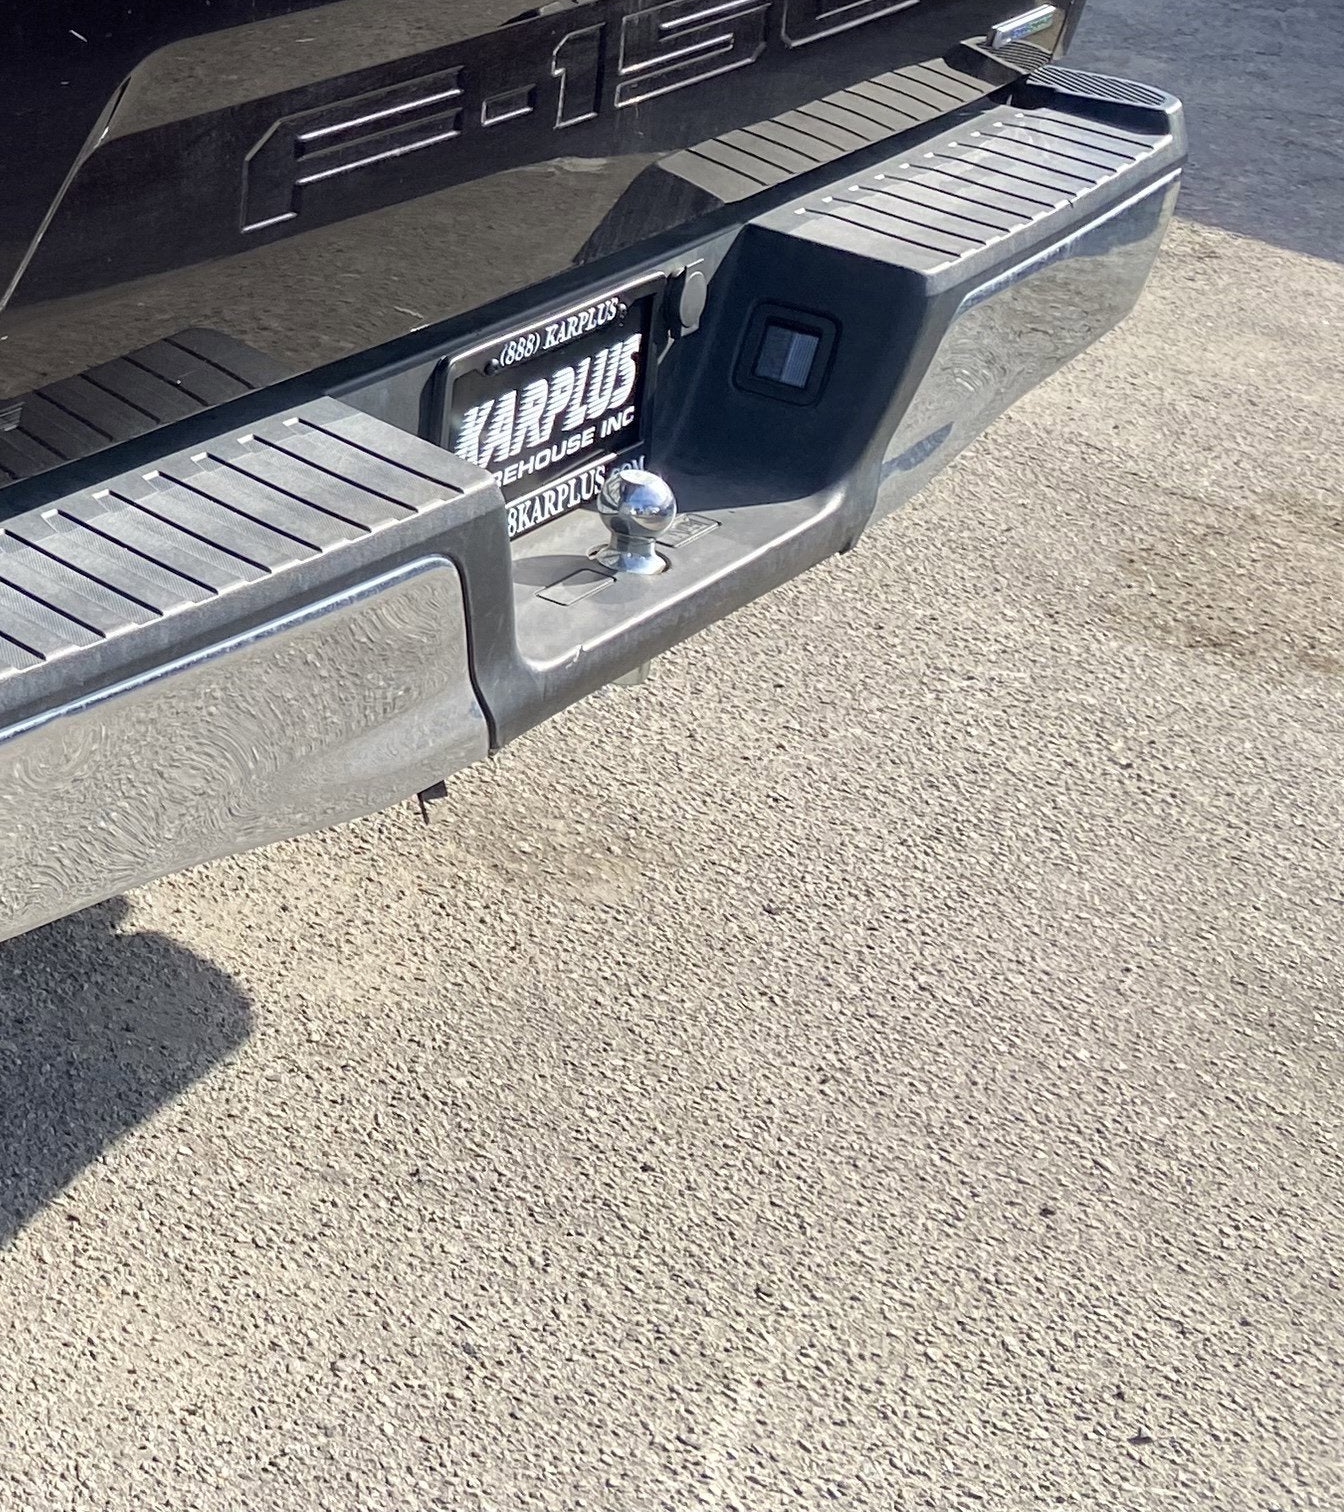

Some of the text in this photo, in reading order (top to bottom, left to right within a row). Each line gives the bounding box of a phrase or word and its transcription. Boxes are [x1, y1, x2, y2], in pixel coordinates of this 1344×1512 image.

[499, 297, 619, 367] (888) KARPLUS
[454, 333, 642, 469] KARPLUS
[492, 405, 635, 488] REHOUSE INC
